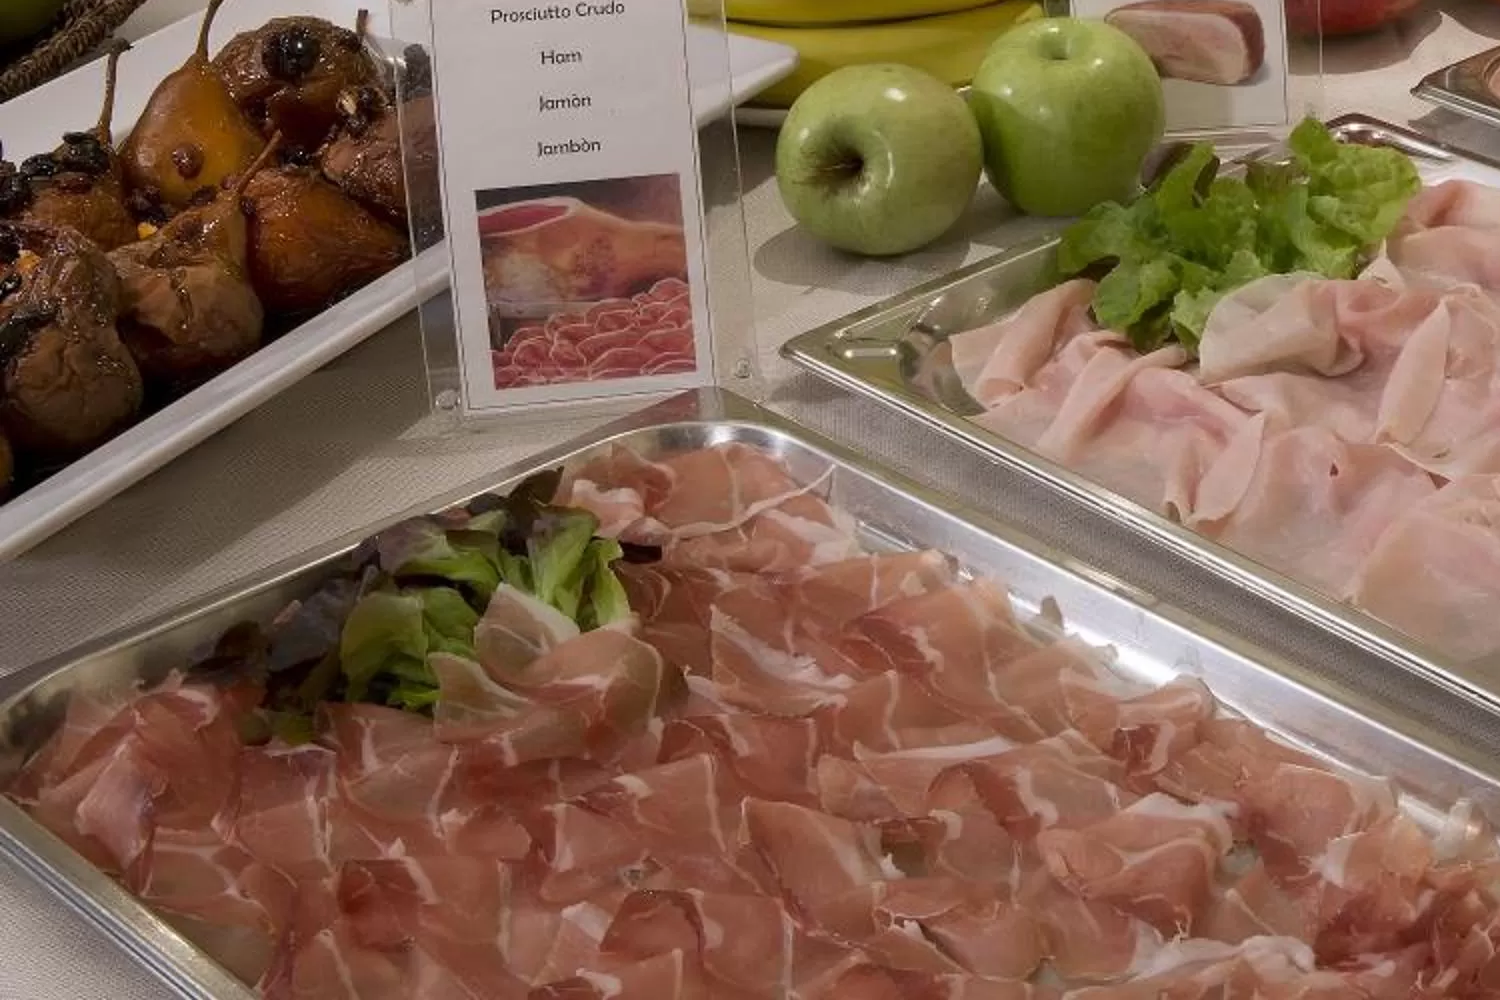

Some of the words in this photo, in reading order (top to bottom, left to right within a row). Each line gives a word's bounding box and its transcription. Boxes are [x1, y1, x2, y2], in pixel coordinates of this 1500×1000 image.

[490, 7, 571, 24] Prosciutto
[575, 0, 625, 17] Crudo
[541, 50, 582, 65] Ham
